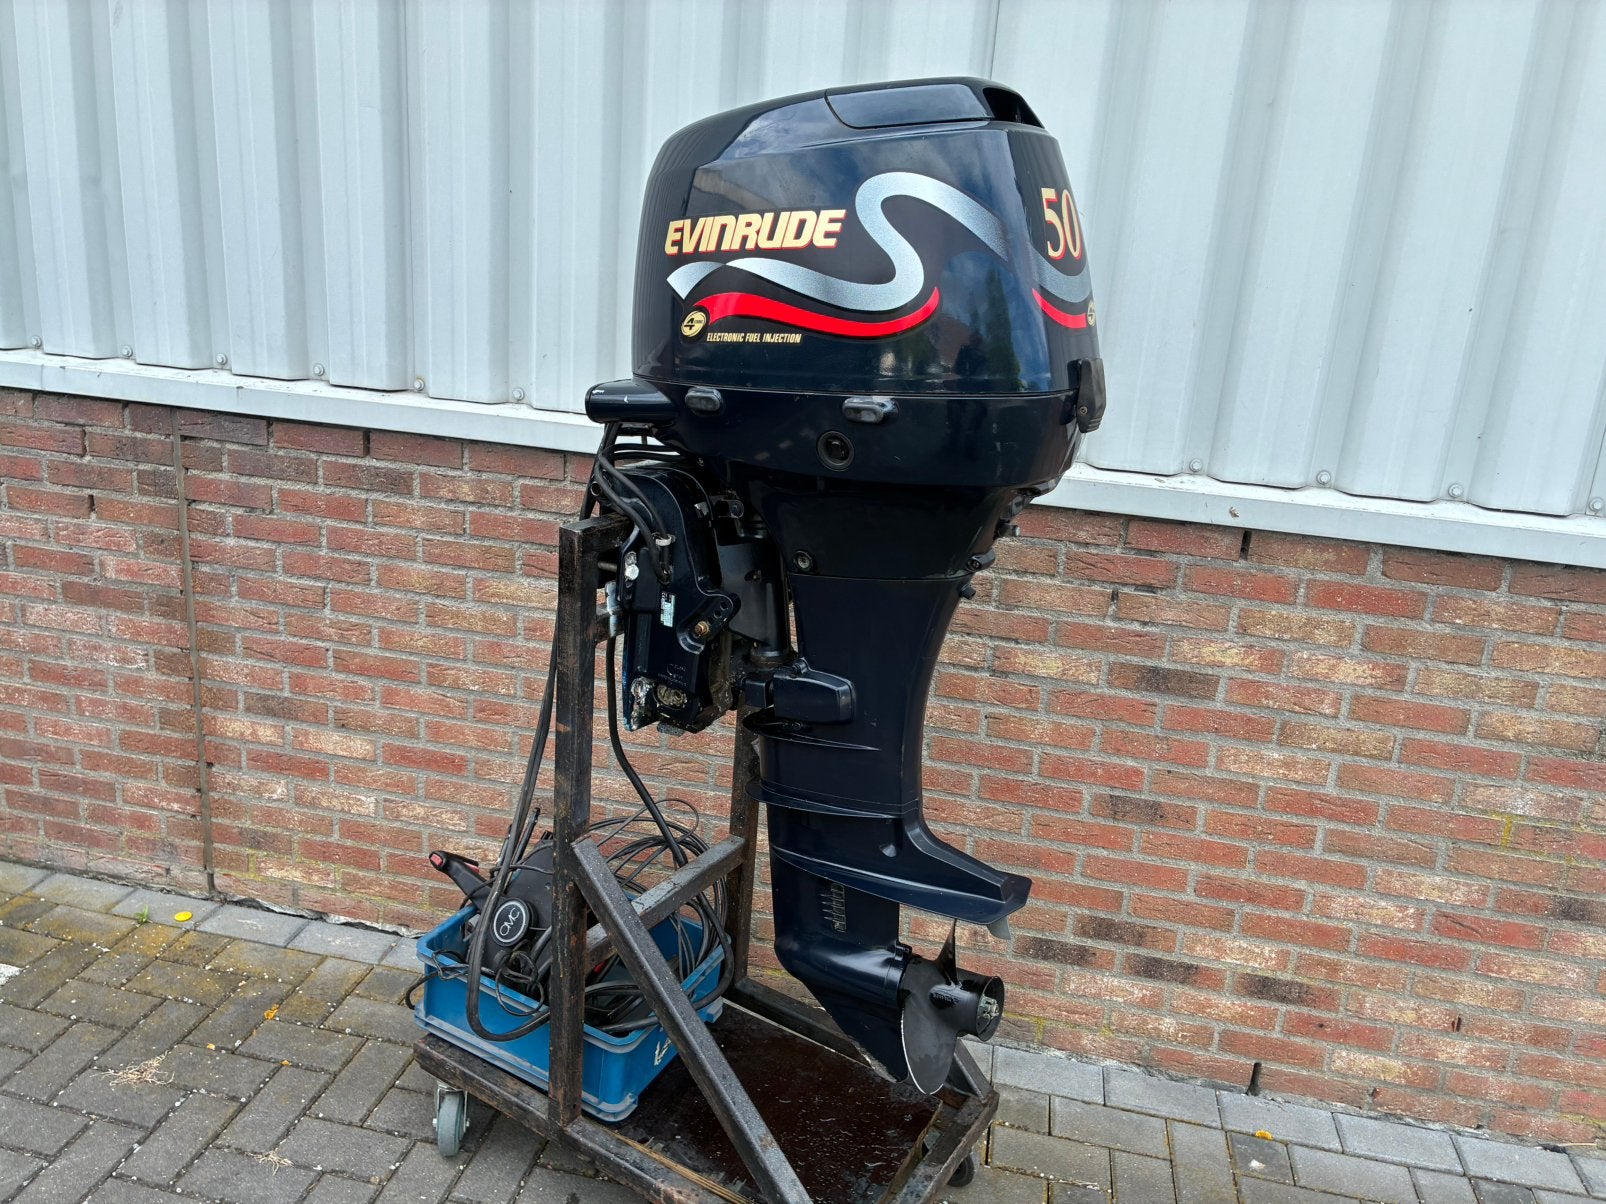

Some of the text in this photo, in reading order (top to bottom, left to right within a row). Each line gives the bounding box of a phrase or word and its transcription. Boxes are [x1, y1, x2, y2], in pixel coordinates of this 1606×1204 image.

[665, 209, 846, 256] EVINRUDE
[1041, 187, 1083, 260] 50
[684, 317, 695, 331] 4
[706, 332, 802, 343] ELECTRONIC FUEL INJECTION
[500, 907, 520, 936] OMC
